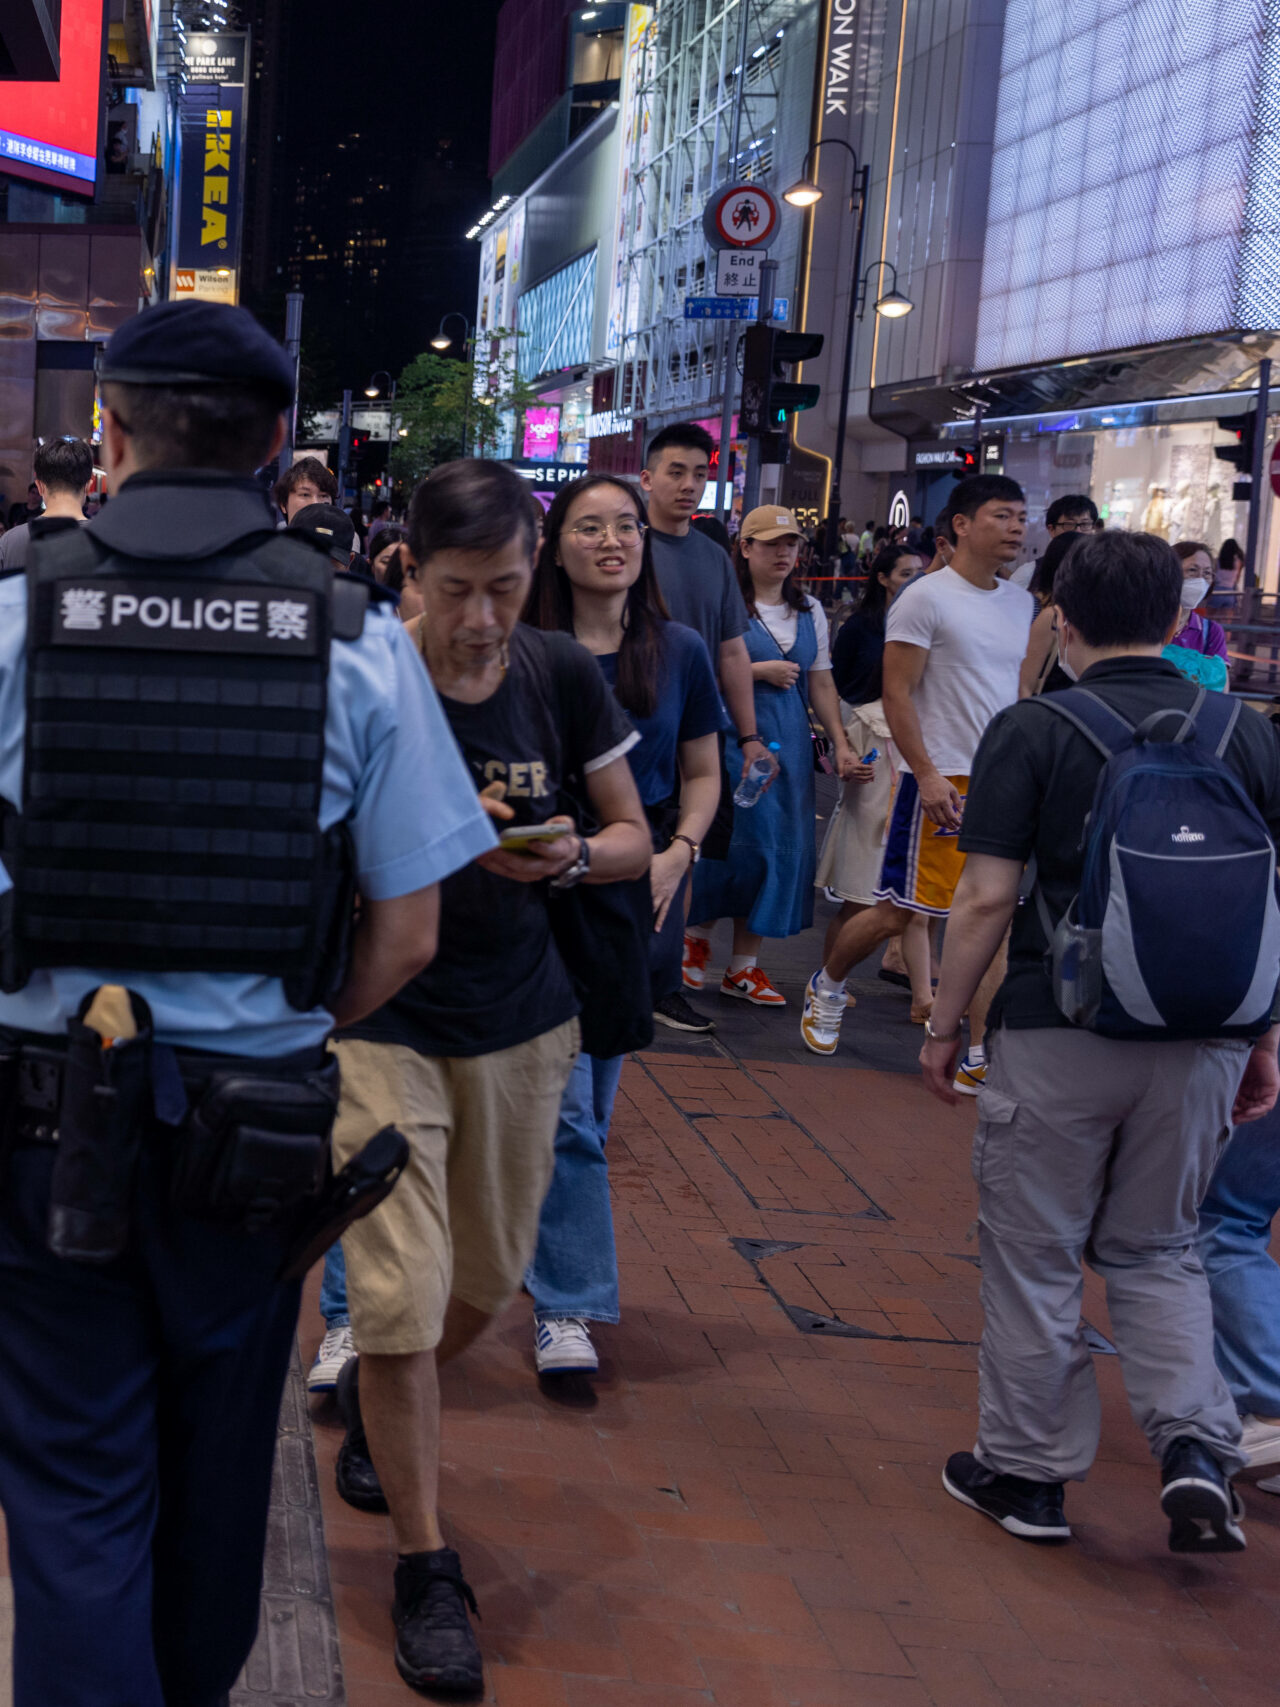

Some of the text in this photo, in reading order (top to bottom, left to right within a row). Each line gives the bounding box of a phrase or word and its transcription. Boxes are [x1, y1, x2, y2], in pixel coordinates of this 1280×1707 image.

[825, 42, 853, 116] WALK
[201, 110, 232, 246] IKEA
[730, 255, 755, 267] End
[198, 275, 229, 284] Wilson
[723, 271, 757, 288] 終止
[60, 587, 309, 640] 警 POLICE 察
